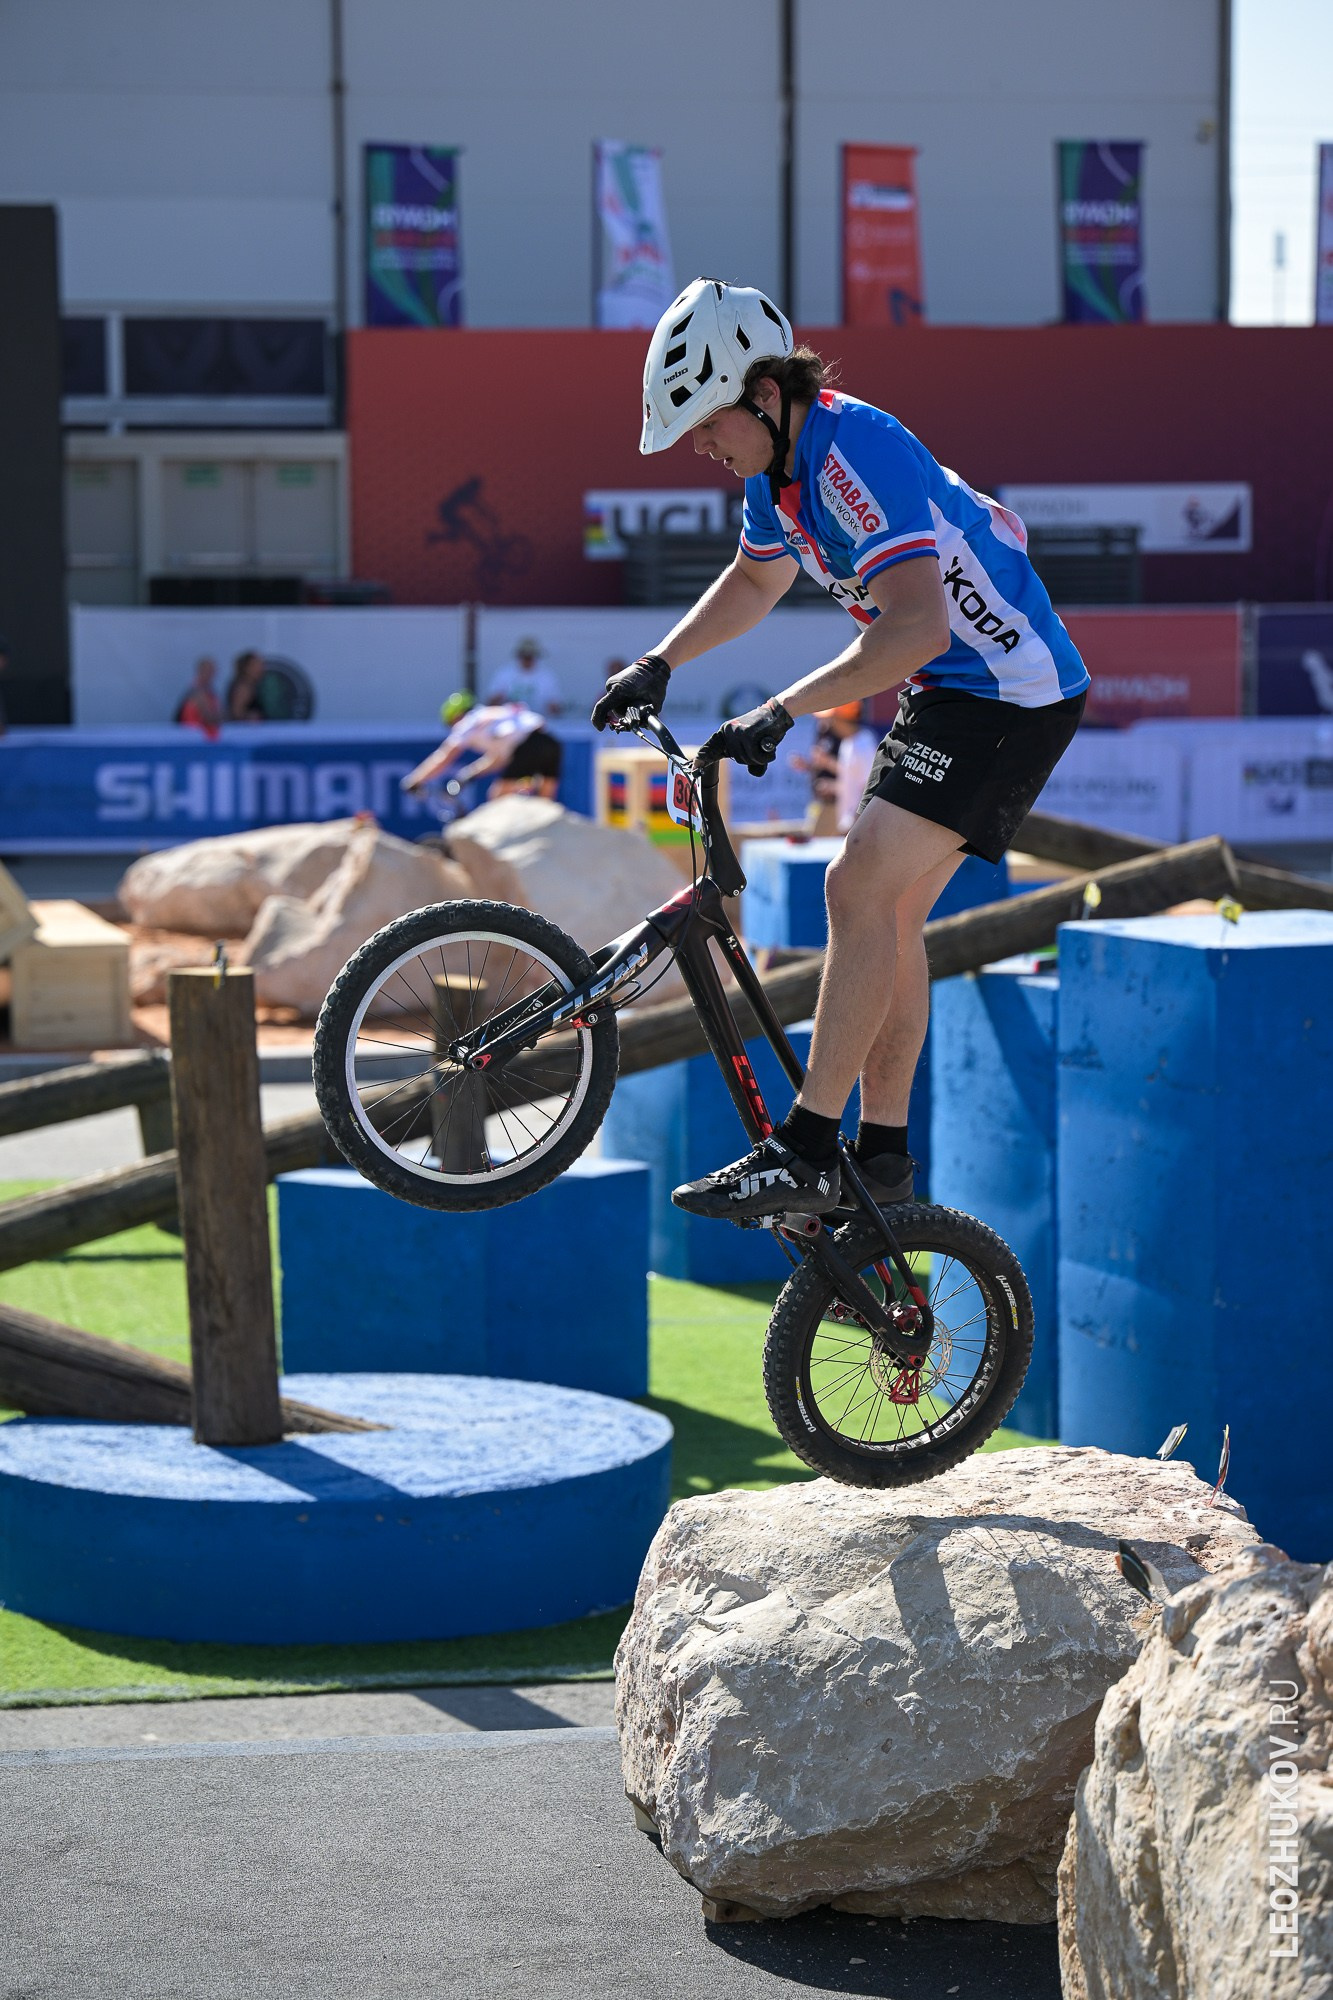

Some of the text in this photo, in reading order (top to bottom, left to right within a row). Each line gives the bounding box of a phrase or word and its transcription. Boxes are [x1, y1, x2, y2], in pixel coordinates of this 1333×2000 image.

[664, 368, 689, 385] hebo
[823, 453, 881, 533] STRABAG
[901, 754, 945, 782] TRIALS
[904, 771, 923, 784] team
[97, 761, 476, 822] SHIMAN
[553, 942, 649, 1022] CLEAN
